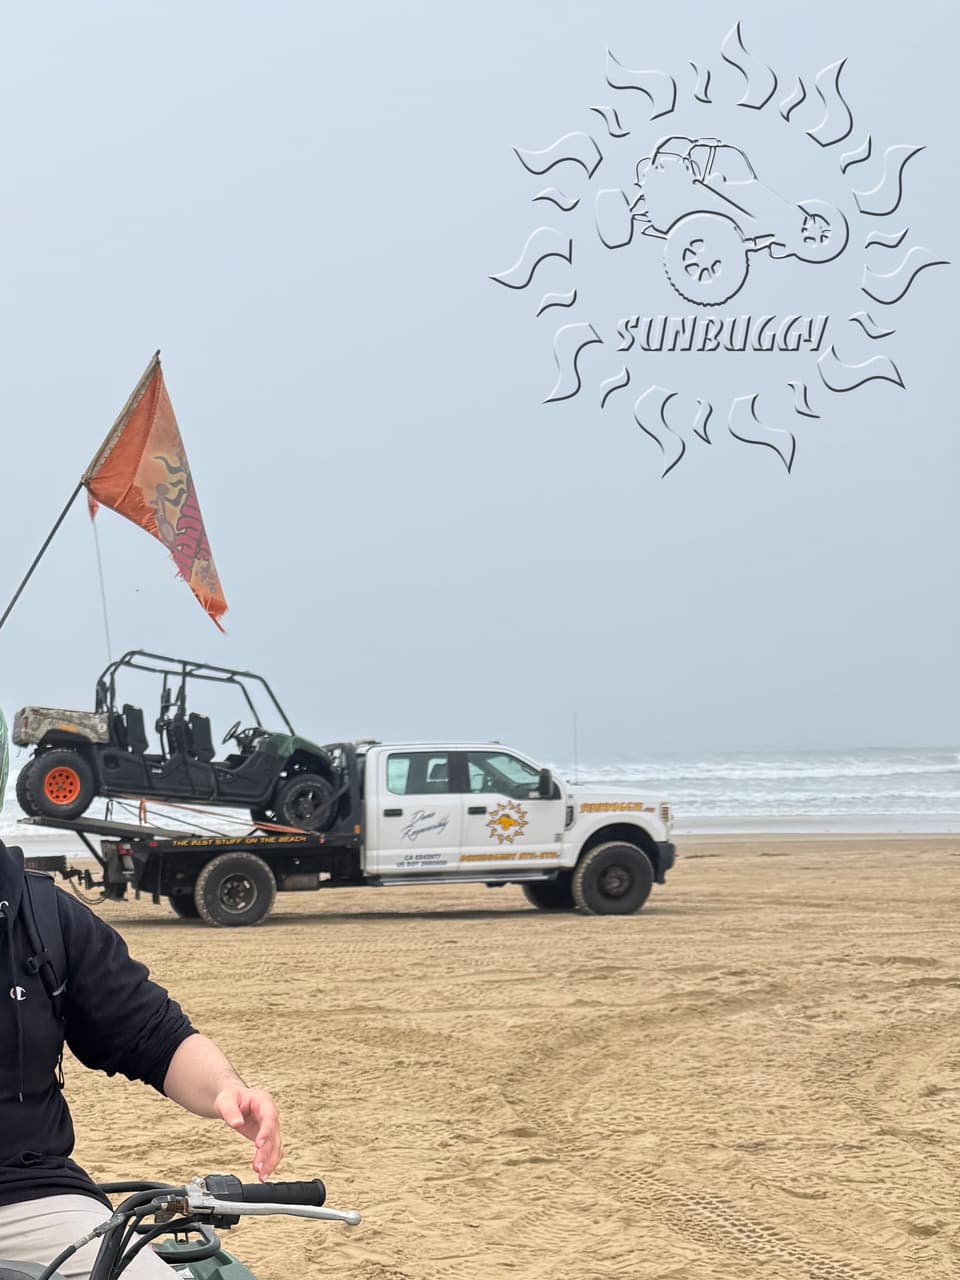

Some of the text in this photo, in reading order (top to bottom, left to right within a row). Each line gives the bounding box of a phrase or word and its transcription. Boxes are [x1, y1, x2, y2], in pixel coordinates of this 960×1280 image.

[191, 839, 214, 847] BEST
[244, 836, 258, 845] ON
[260, 835, 278, 844] THE
